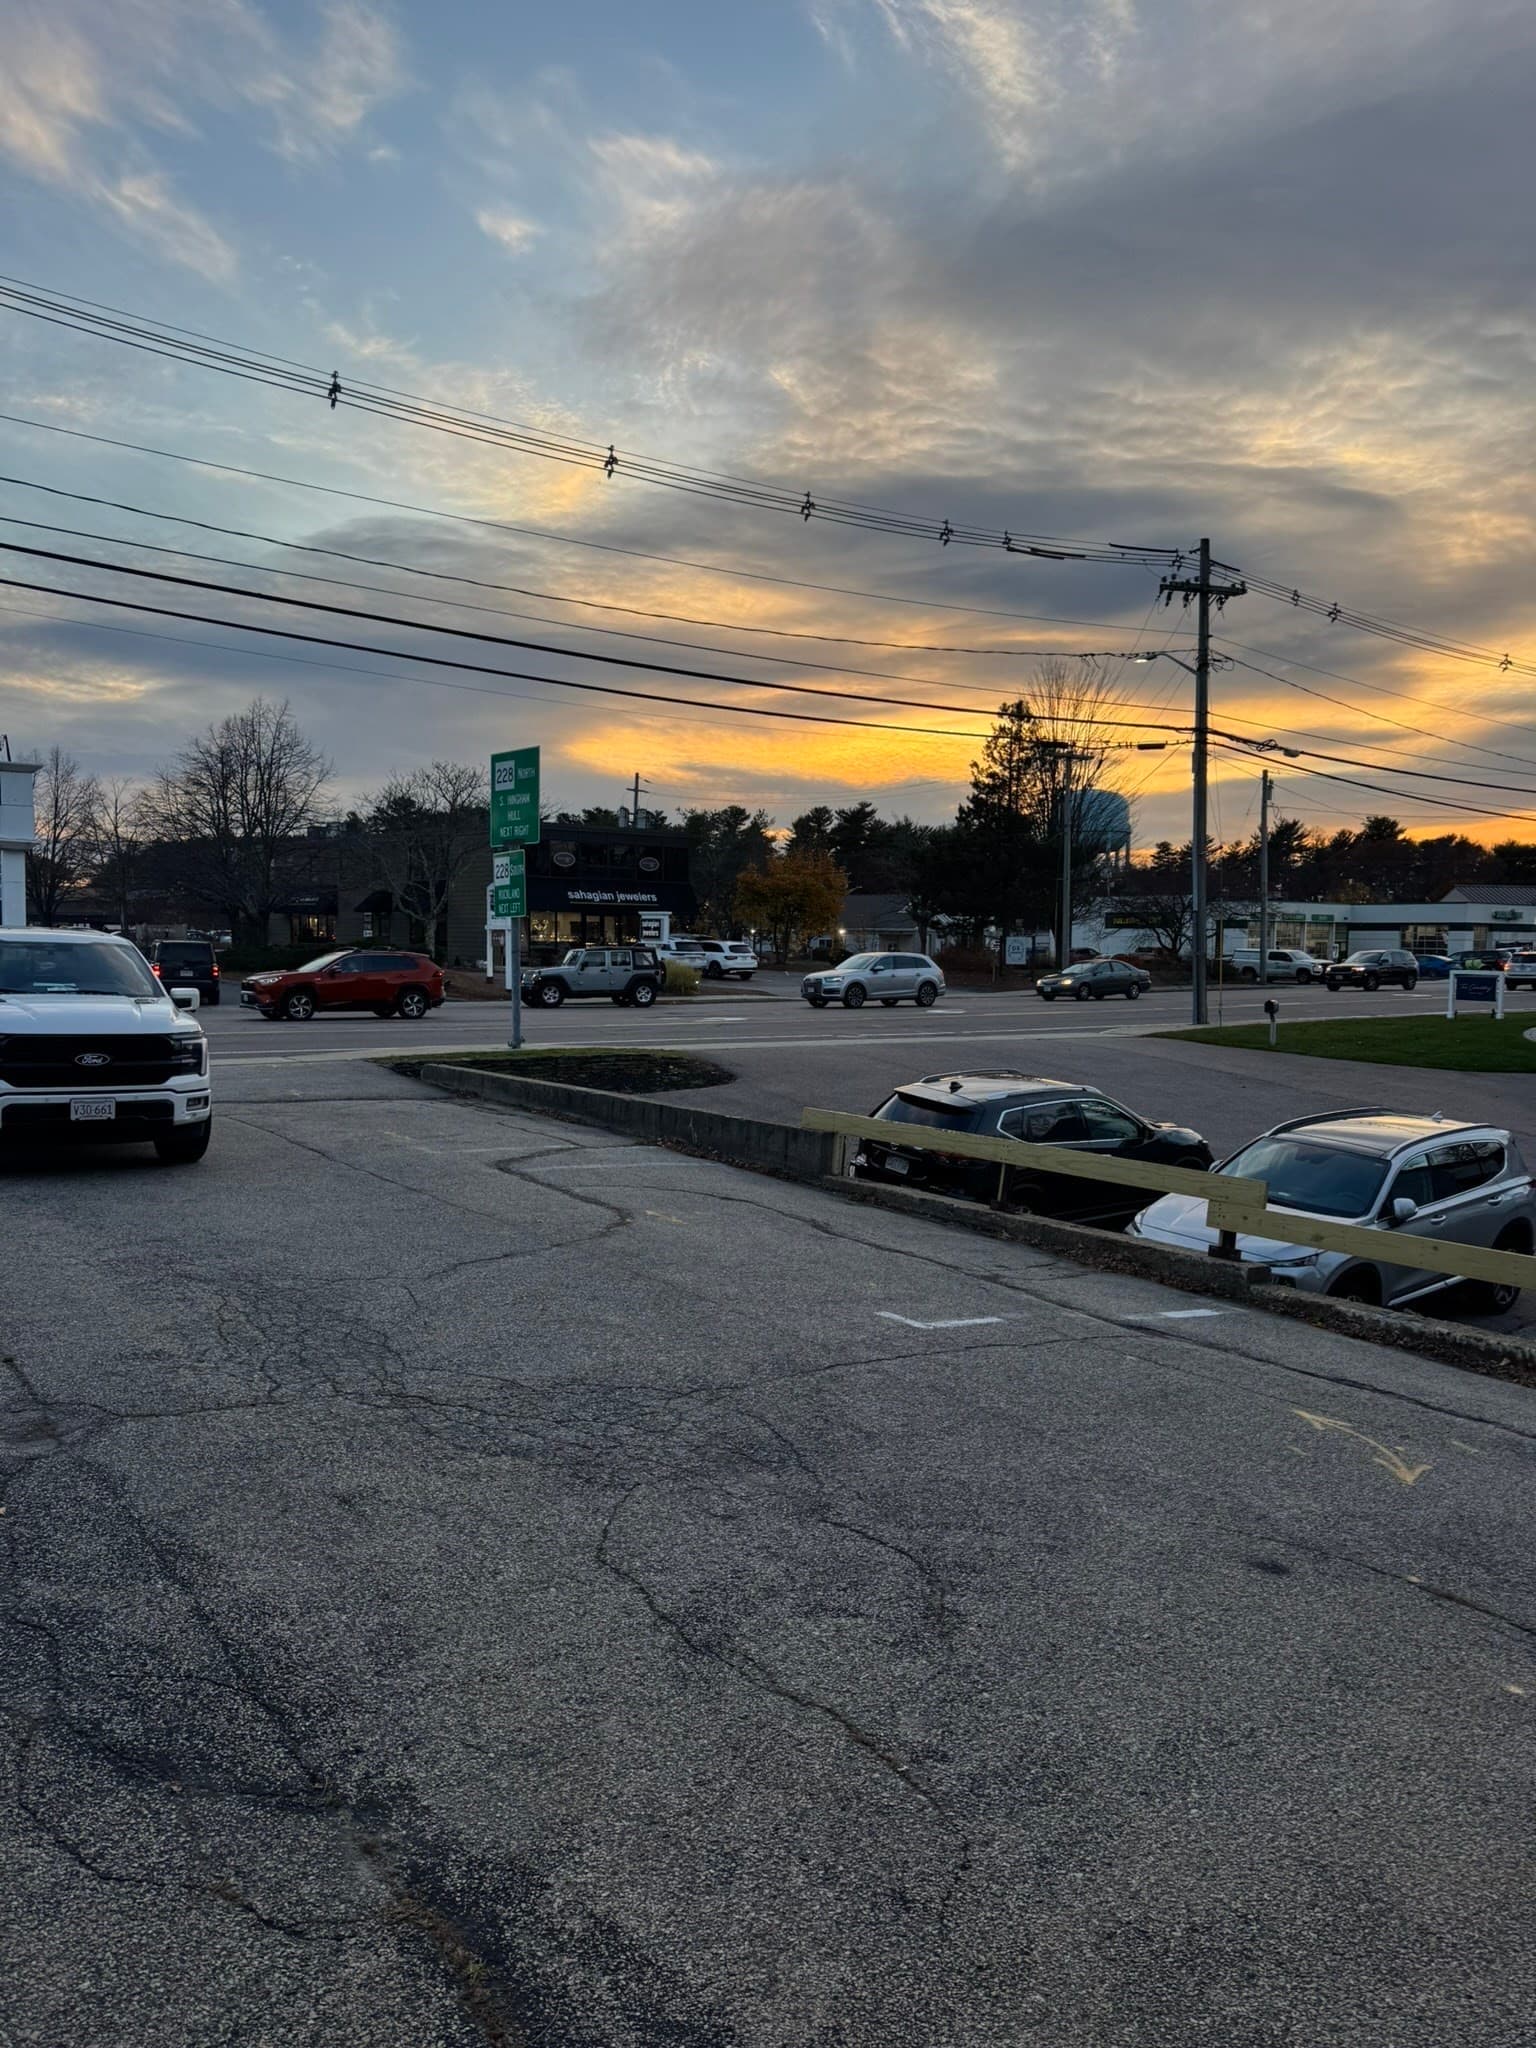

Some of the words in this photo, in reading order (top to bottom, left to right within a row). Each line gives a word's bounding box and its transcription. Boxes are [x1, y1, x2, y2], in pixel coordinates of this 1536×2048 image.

[496, 767, 513, 784] 228
[517, 767, 536, 779] NORTH
[507, 810, 521, 821] HULL
[500, 825, 513, 838] NEXT
[514, 824, 529, 836] RIGHT
[496, 863, 509, 879] 228
[568, 889, 615, 902] sahagian
[616, 890, 657, 903] jewelers
[498, 903, 509, 914] NEXT
[510, 902, 521, 913] LEFT
[82, 1055, 103, 1064] Ford
